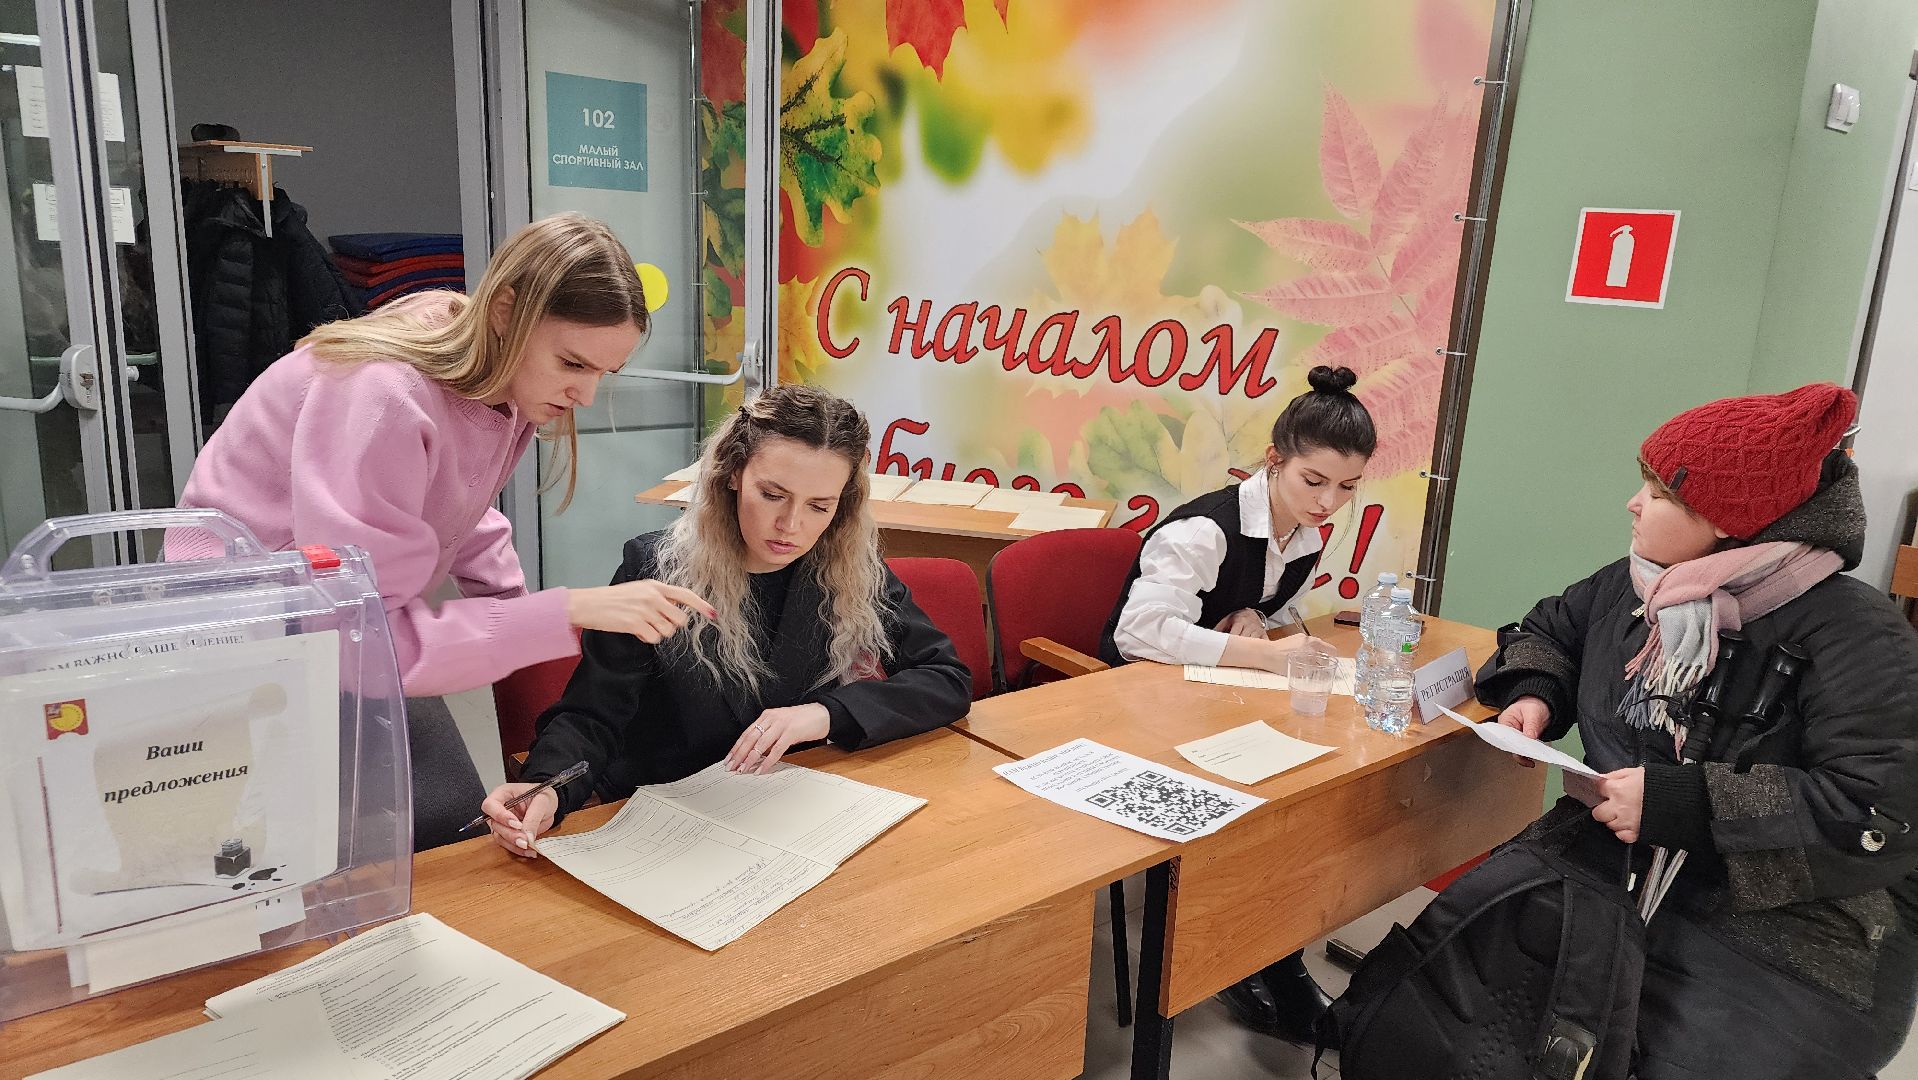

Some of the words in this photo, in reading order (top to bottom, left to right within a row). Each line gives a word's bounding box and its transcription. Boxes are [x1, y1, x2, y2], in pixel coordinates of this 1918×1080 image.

[582, 107, 615, 129] 102
[552, 153, 621, 169] СПОРТИВНЫЙ
[623, 160, 644, 171] ЗАЛ
[578, 144, 619, 157] МАЛЫЙ
[816, 267, 871, 359] С
[887, 295, 1279, 399] началом
[1419, 666, 1470, 703] РЕГИСТРАЦИЯ
[145, 738, 204, 761] Ваши
[103, 763, 249, 804] предложения
